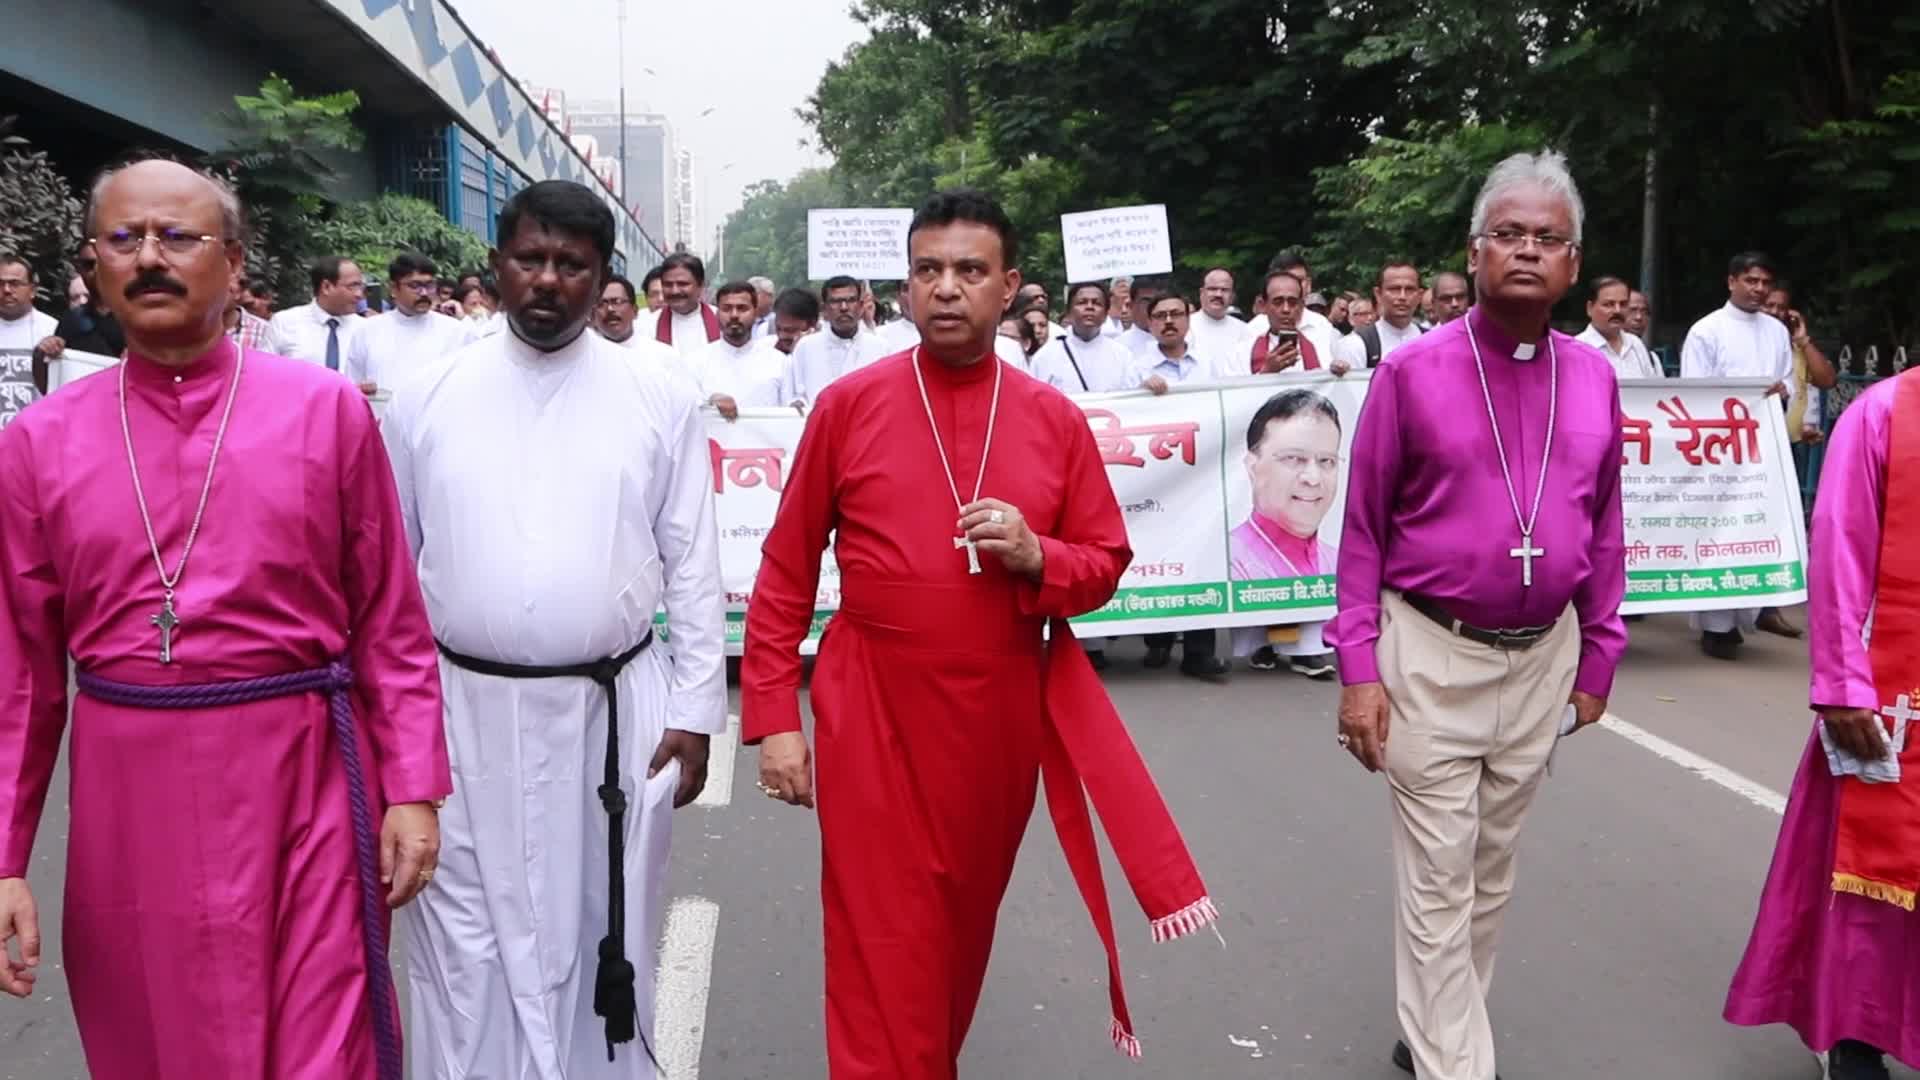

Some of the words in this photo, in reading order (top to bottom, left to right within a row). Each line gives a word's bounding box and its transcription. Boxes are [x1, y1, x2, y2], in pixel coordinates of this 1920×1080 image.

[1656, 395, 1763, 466] रैली
[1695, 534, 1783, 564] (कोलकाता)
[1238, 583, 1292, 604] संचालक
